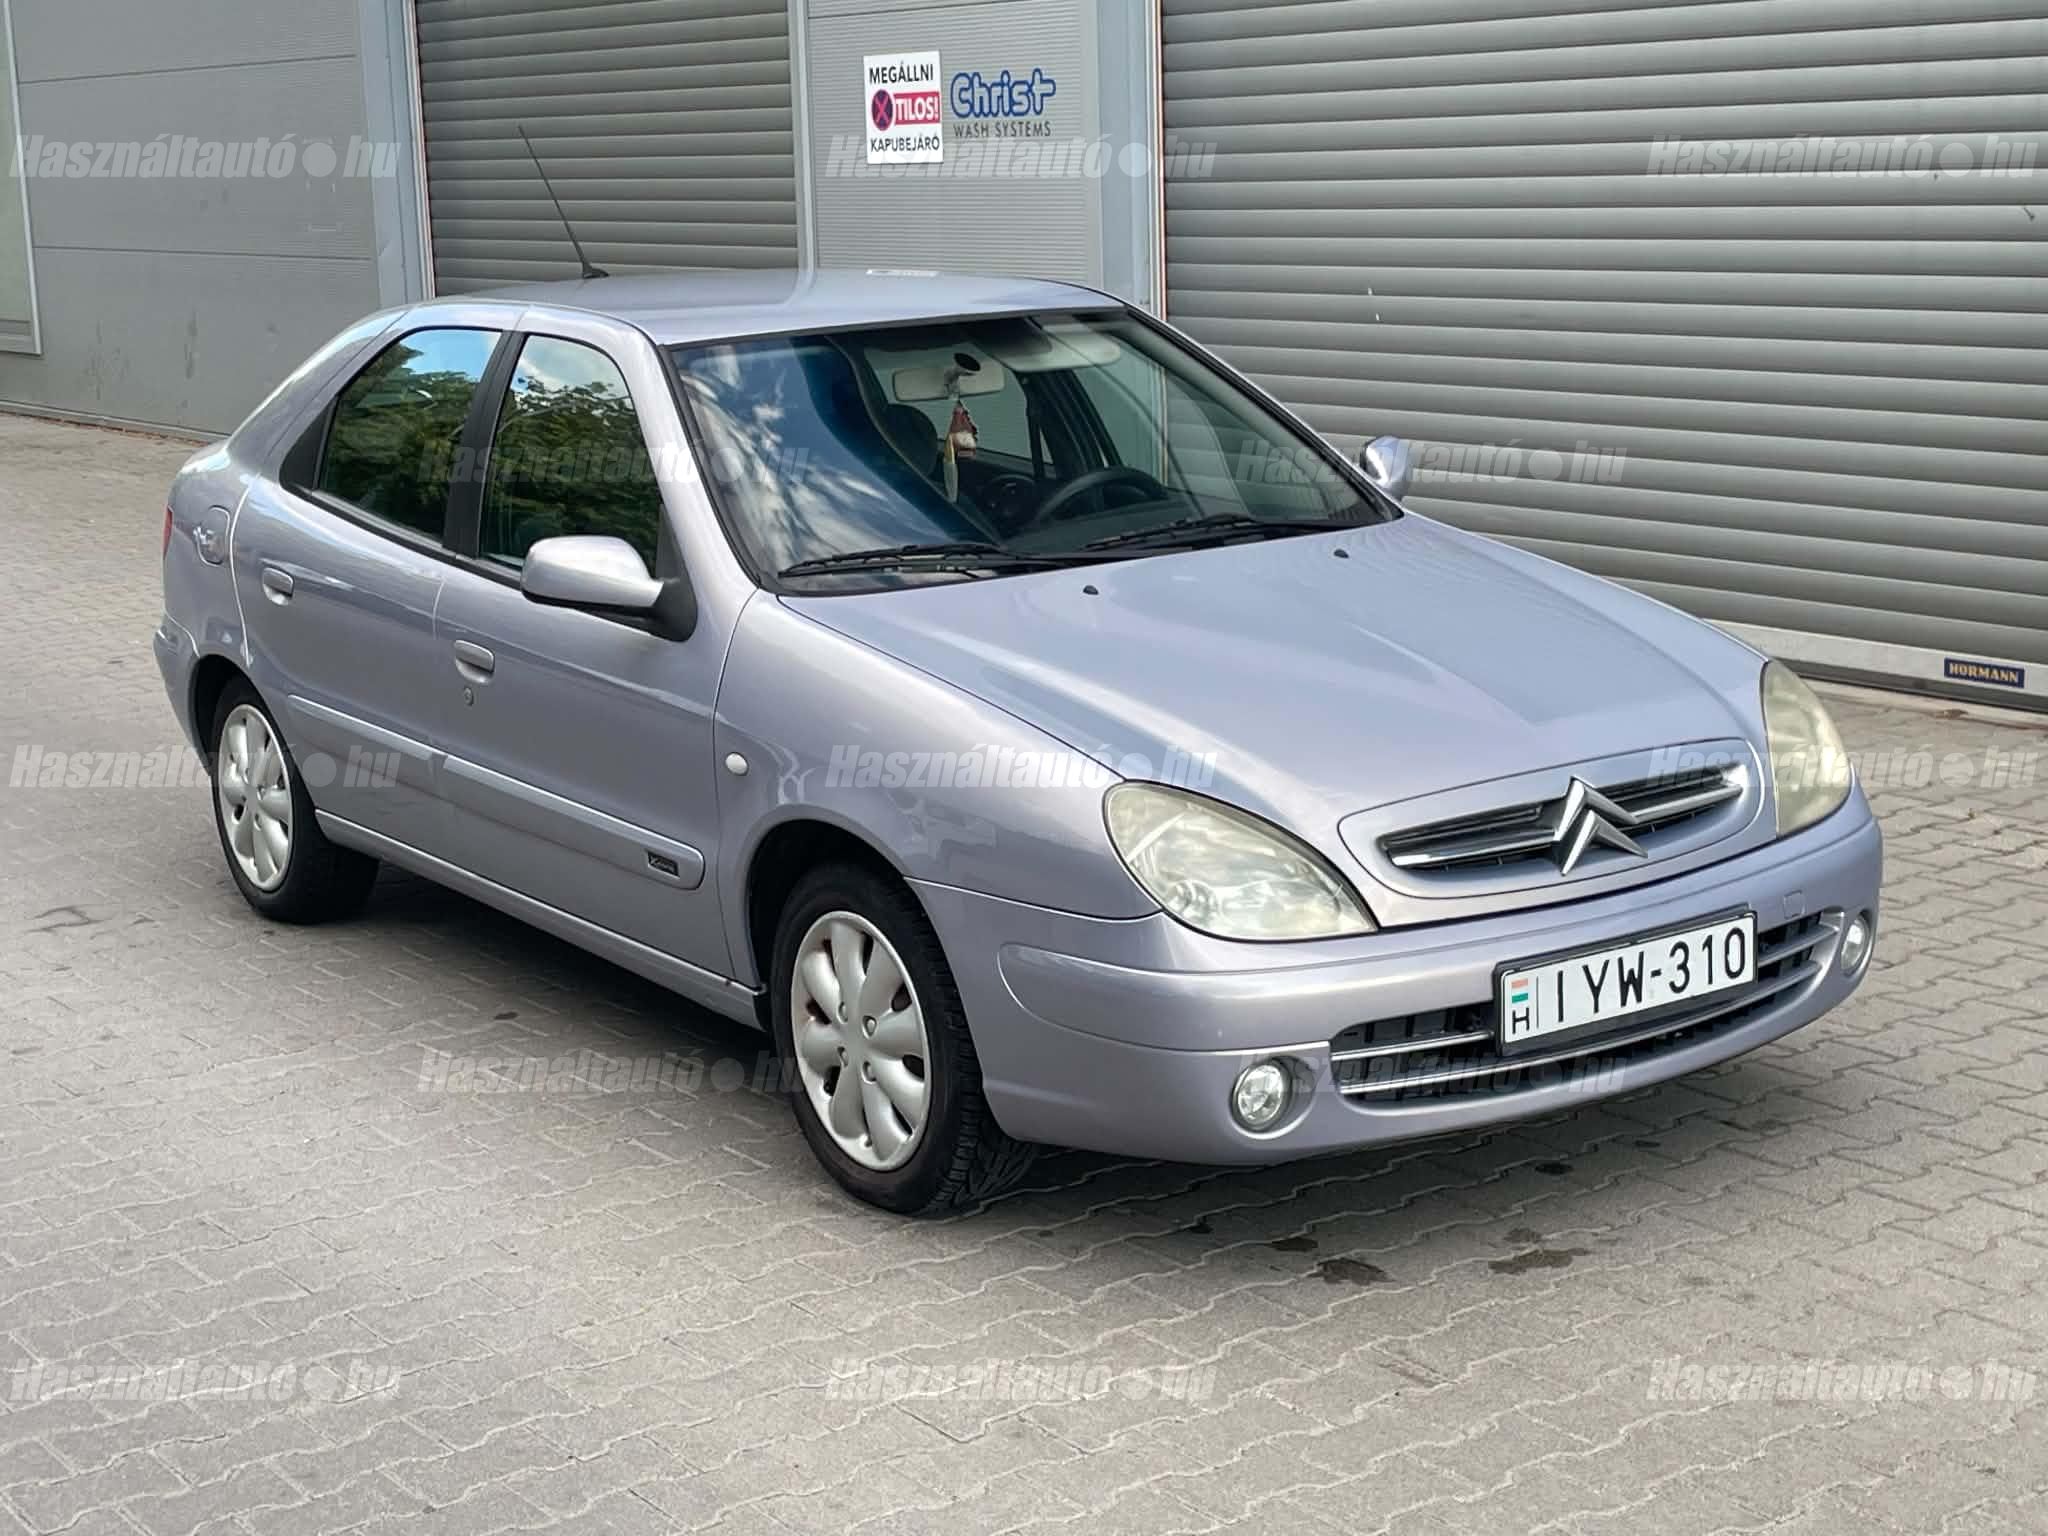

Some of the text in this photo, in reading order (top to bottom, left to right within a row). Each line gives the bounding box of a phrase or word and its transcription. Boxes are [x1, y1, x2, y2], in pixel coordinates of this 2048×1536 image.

[869, 60, 934, 85] MEGÁLLNI
[950, 68, 1056, 118] Christ
[895, 95, 939, 121] TILOS!
[953, 121, 1051, 138] WASH SYSTEMS
[870, 133, 940, 153] KAPUBEJÁRÓ
[1511, 926, 1746, 1035] H IYW-310
